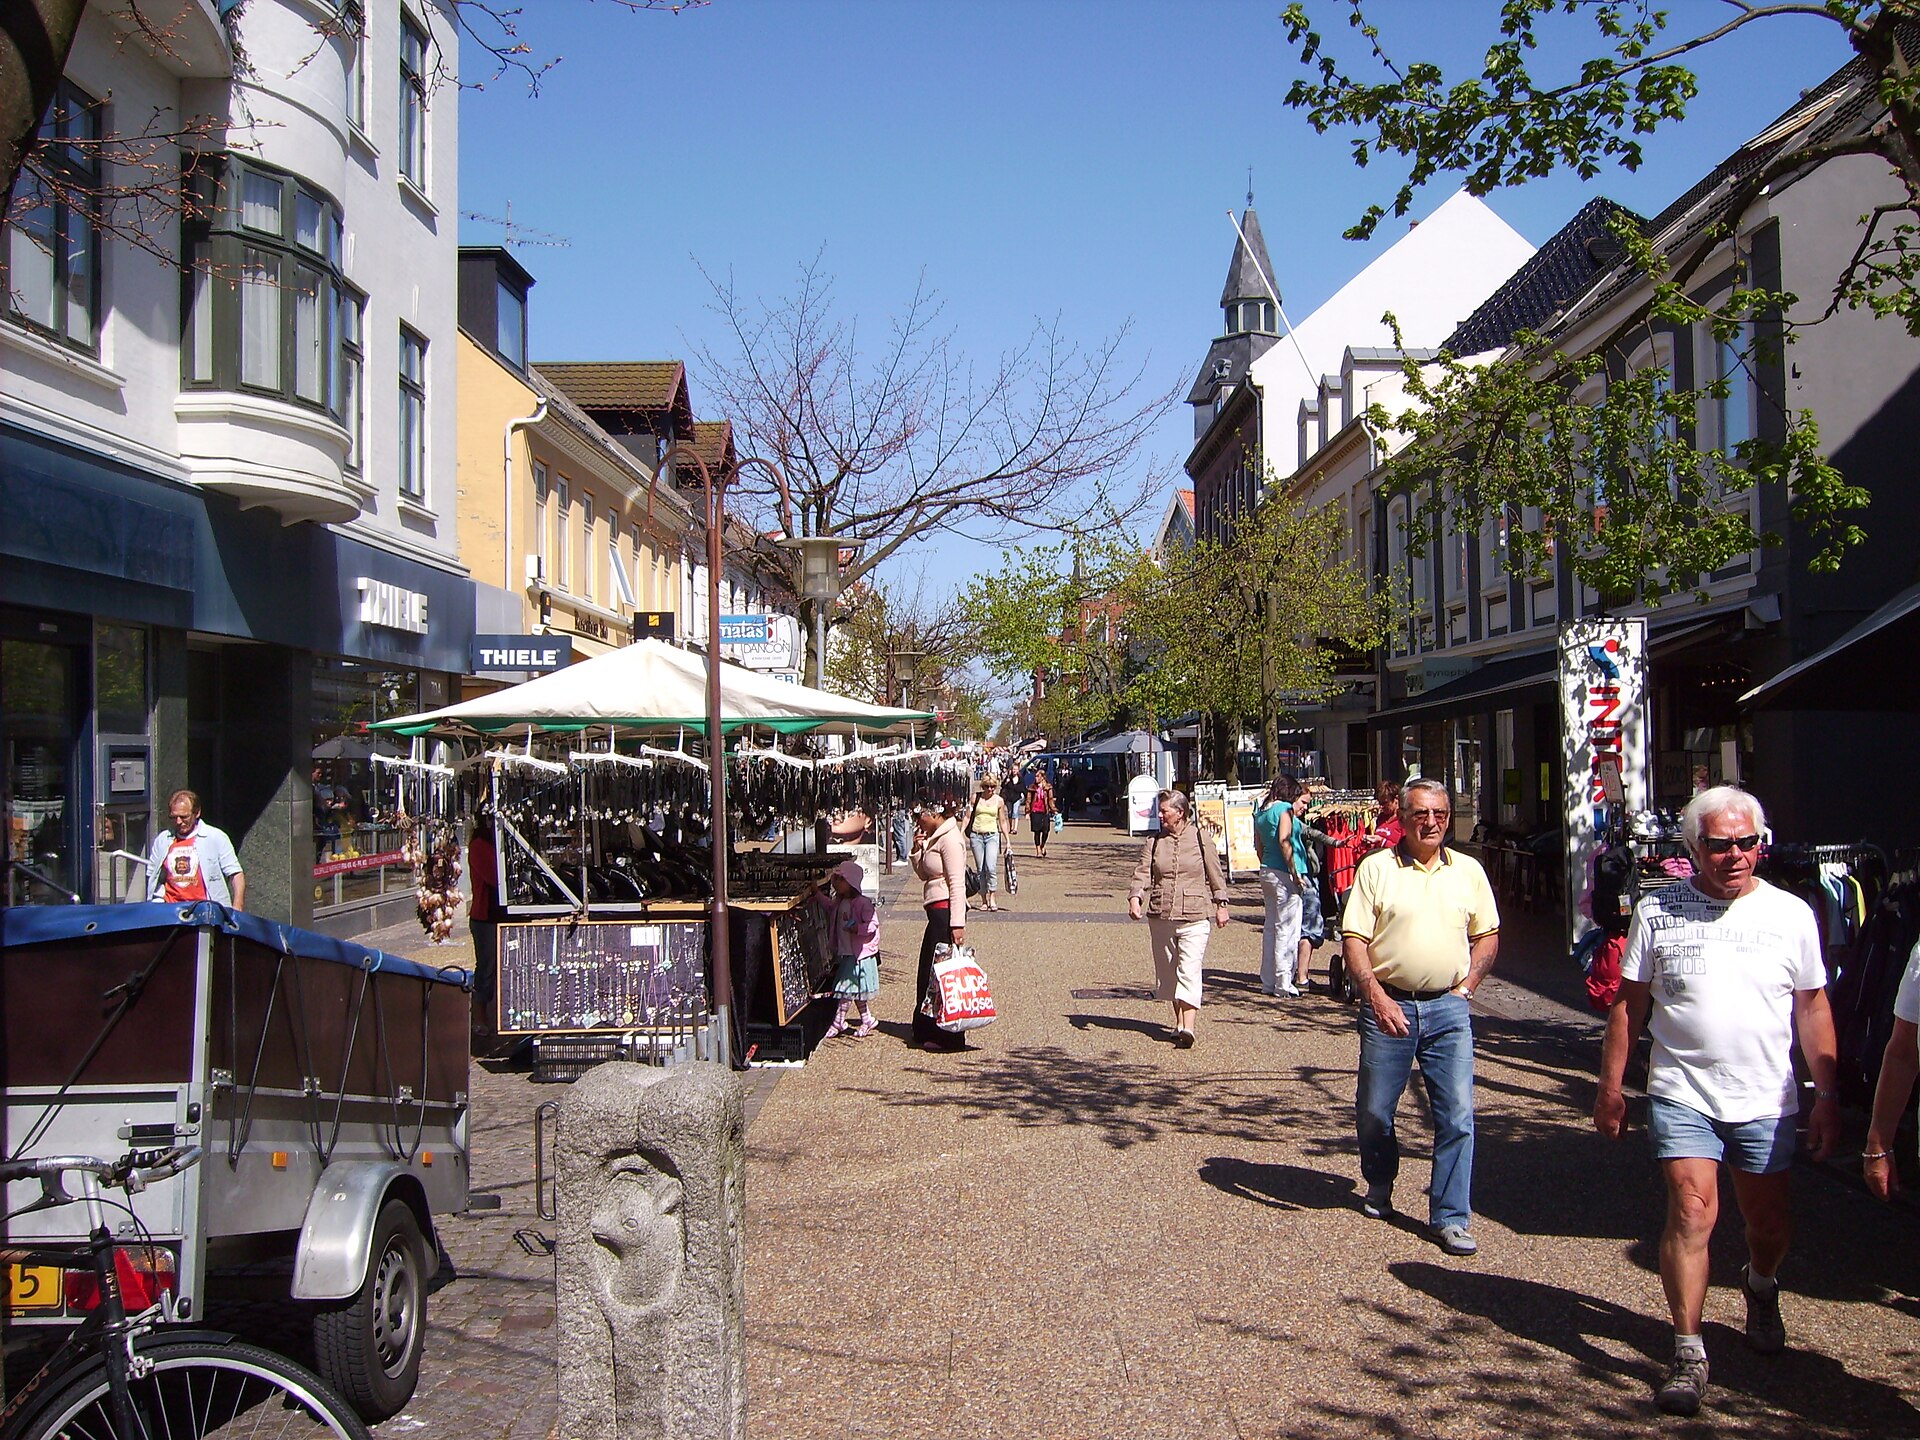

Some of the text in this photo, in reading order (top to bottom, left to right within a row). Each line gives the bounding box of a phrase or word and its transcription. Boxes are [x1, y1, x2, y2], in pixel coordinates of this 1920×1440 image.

[357, 577, 429, 635] THIELE
[480, 649, 557, 665] THIELE
[1653, 944, 1700, 957] ADMISSION
